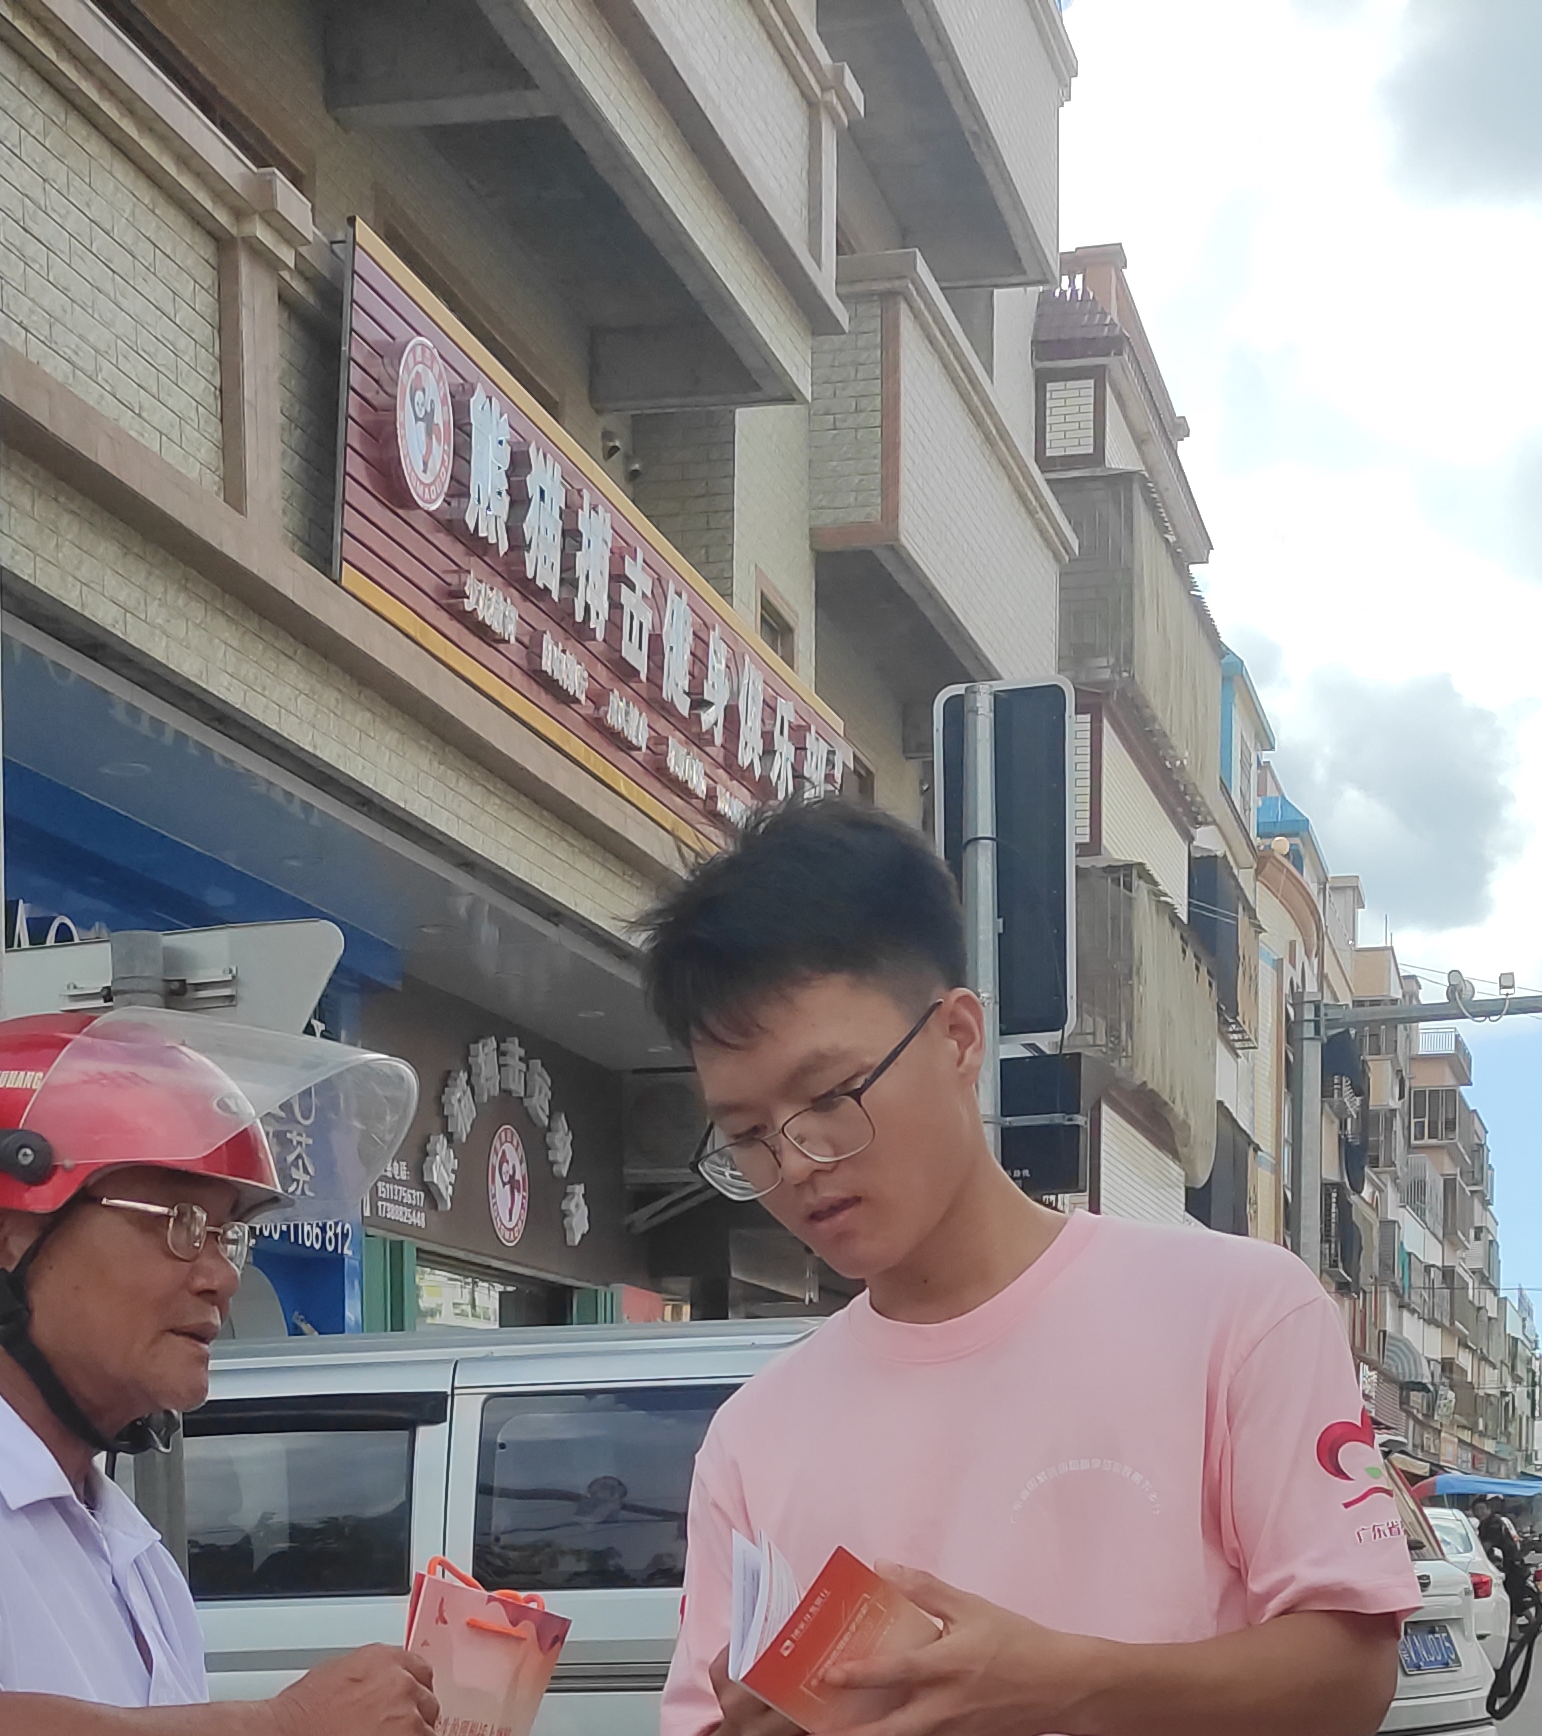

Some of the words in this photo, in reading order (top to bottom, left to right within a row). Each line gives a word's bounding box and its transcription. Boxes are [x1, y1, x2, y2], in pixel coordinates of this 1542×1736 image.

[326, 1221, 352, 1256] 812
[1356, 1520, 1406, 1544] 广东省
